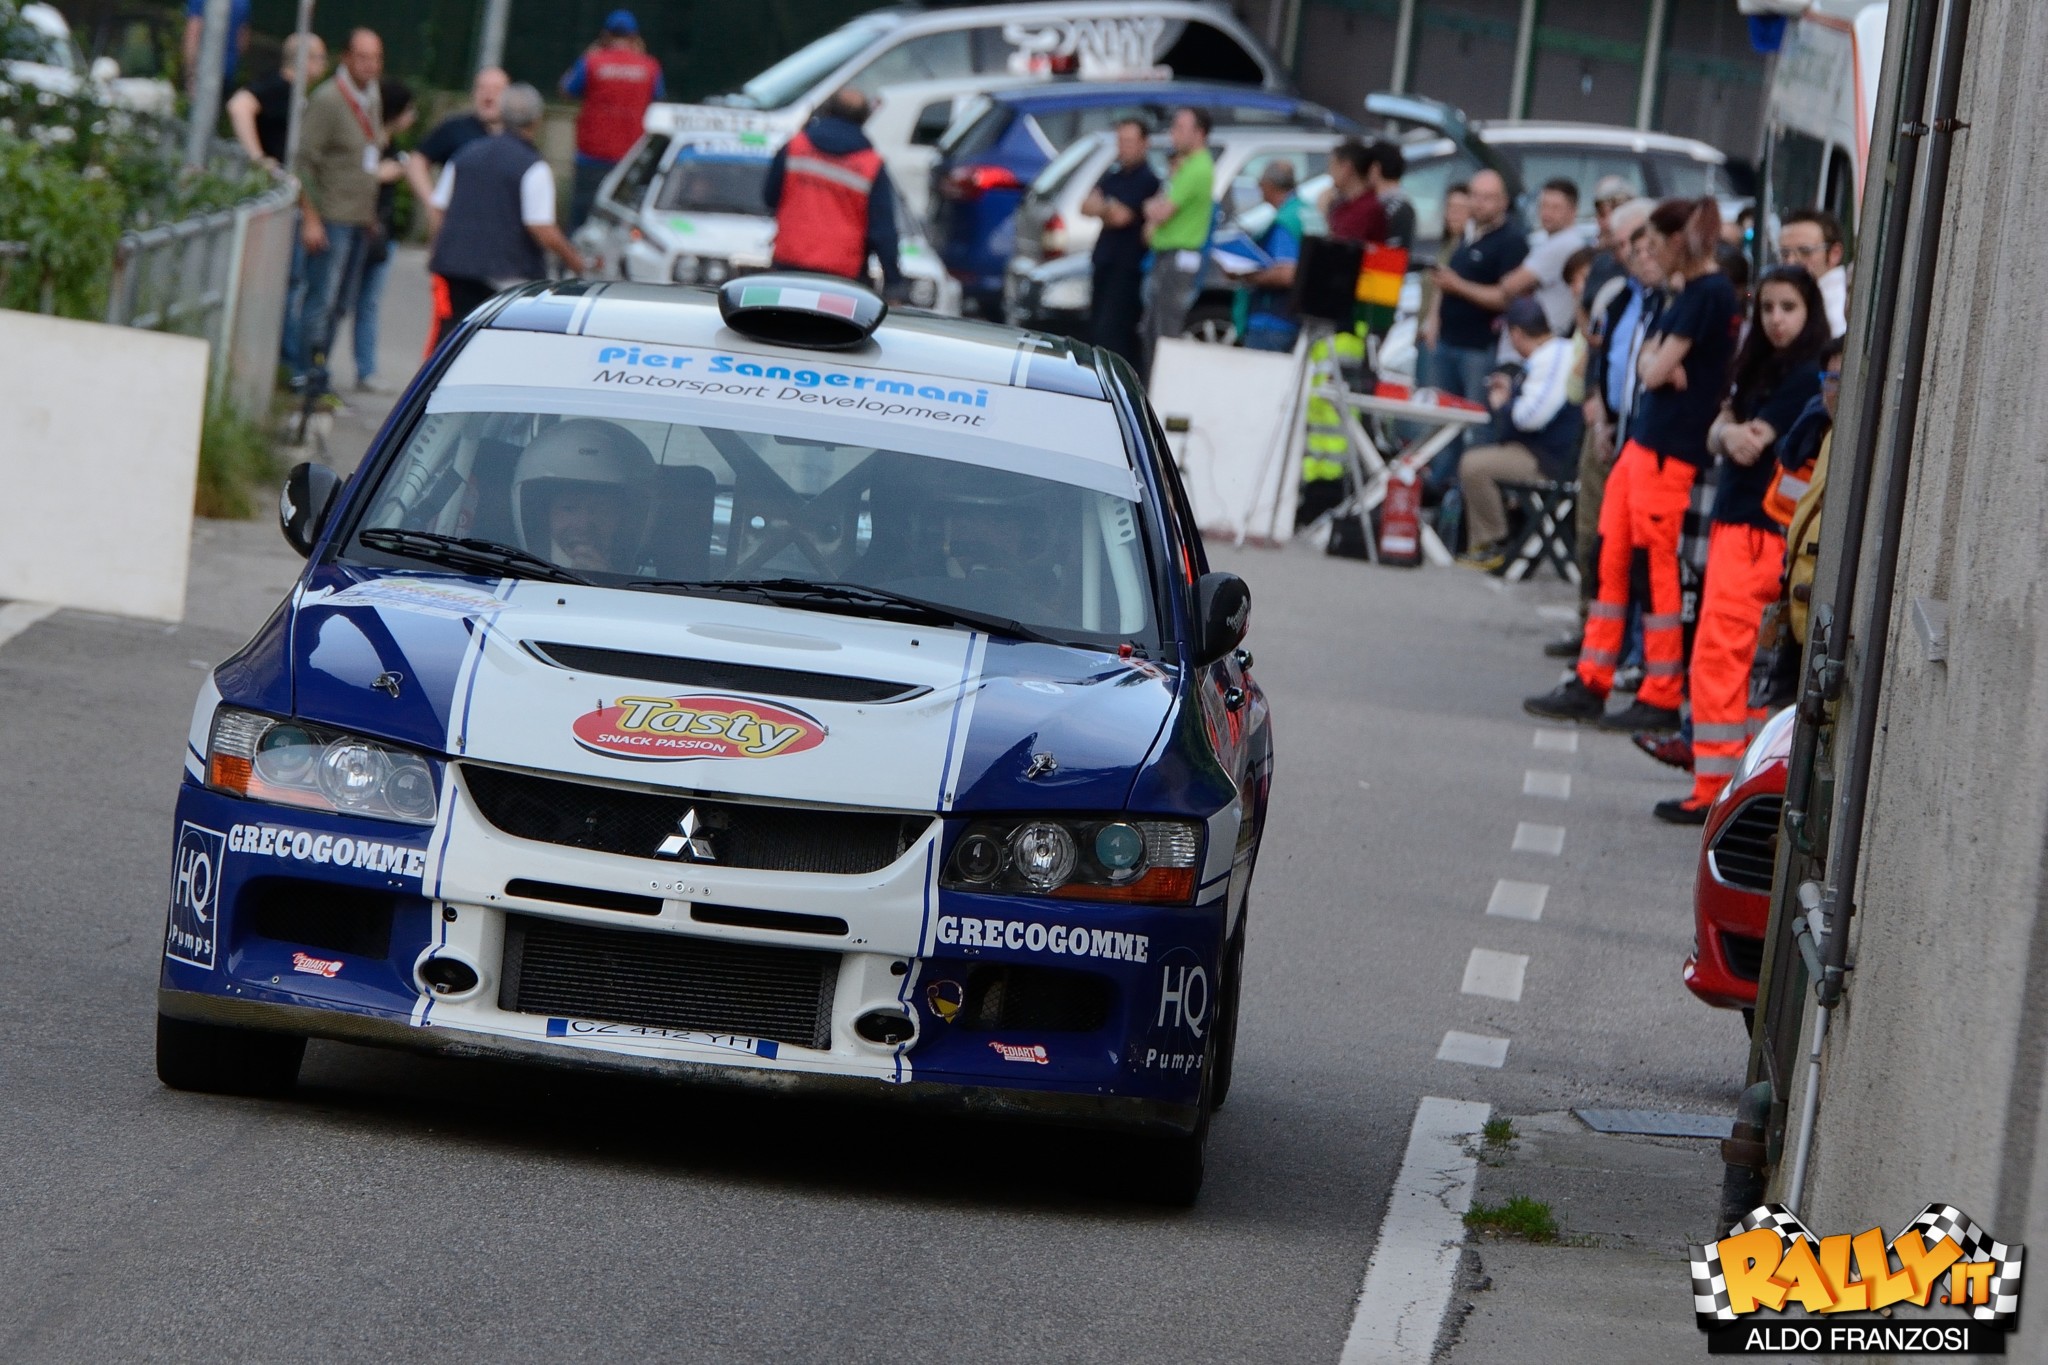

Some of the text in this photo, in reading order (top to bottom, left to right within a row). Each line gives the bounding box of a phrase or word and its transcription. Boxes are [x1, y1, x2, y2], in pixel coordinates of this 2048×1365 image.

[593, 369, 986, 428] Motorsport Development
[597, 346, 989, 409] Pier Sangermani
[597, 734, 727, 753] SNACK PASSION
[621, 698, 800, 754] Tasty
[228, 824, 428, 878] GRECOGOMME
[176, 846, 212, 923] HQ
[172, 924, 212, 956] Pumps
[936, 915, 1149, 964] GRECOGOMME
[1157, 965, 1208, 1039] HQ
[630, 1027, 690, 1040] 442
[705, 1033, 753, 1049] YH
[1145, 1047, 1204, 1075] Pumps
